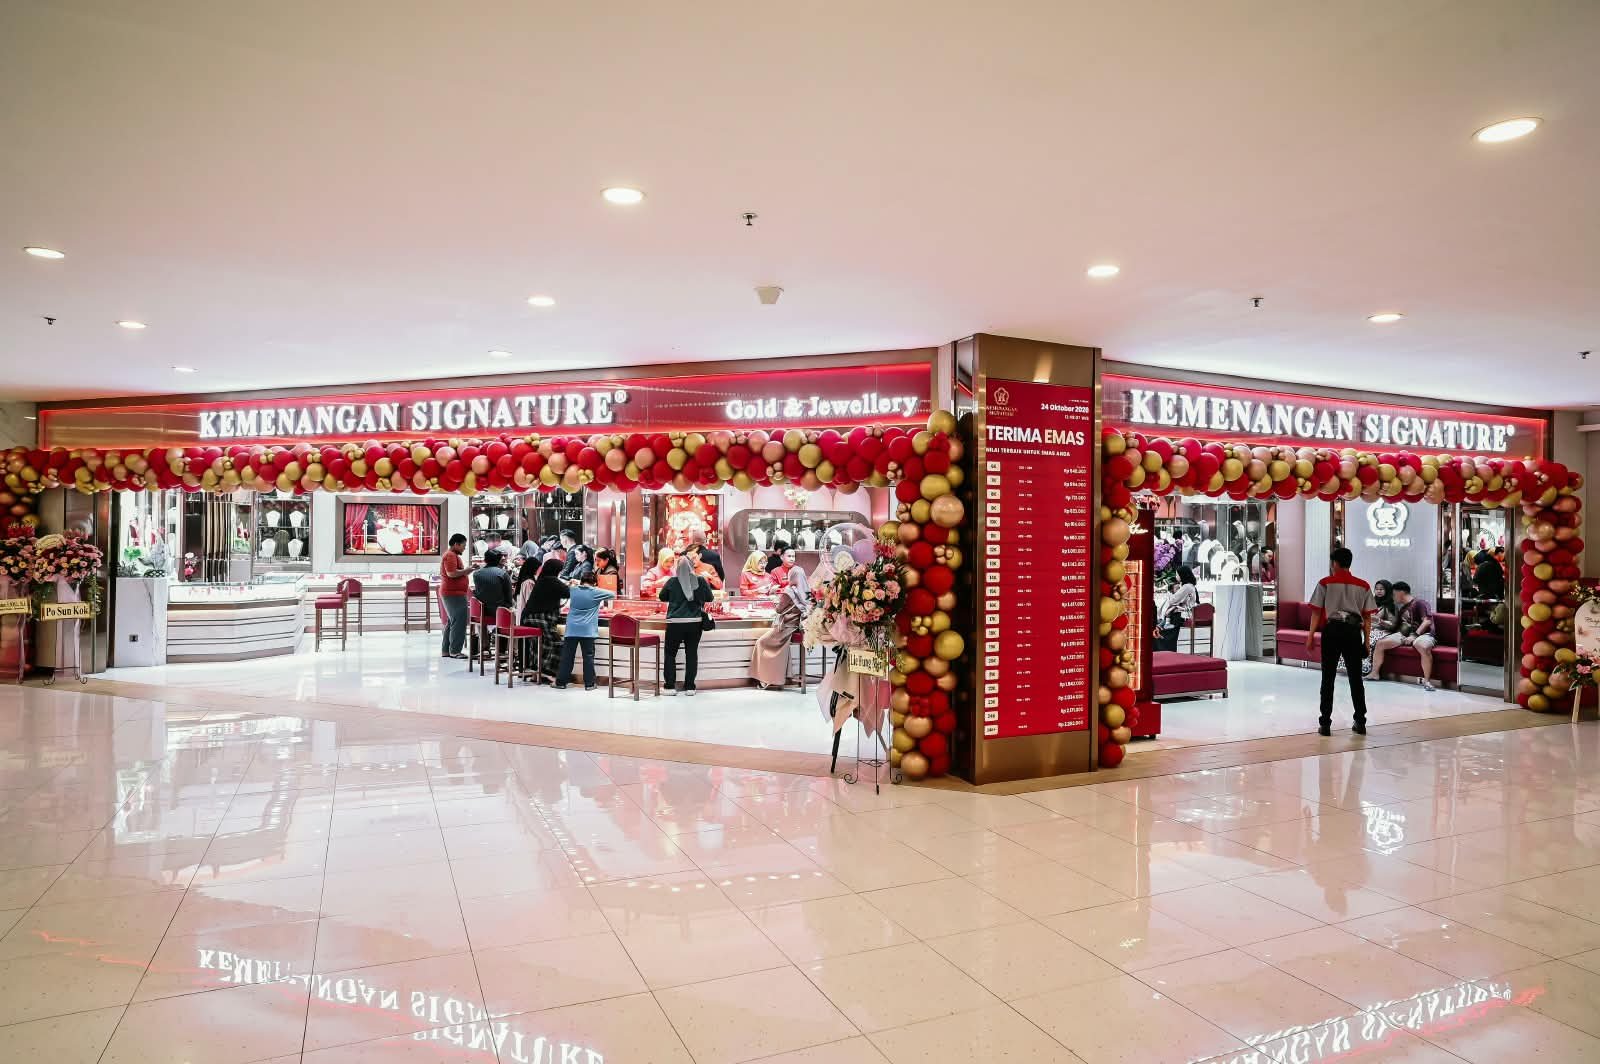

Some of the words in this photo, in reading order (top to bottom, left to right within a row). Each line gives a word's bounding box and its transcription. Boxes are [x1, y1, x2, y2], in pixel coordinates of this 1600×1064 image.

[726, 398, 778, 419] Gold
[784, 397, 802, 418] &
[808, 393, 918, 417] Jewellery
[1050, 404, 1074, 412] Oktober
[198, 402, 399, 438] KEMENANGAN
[1130, 388, 1354, 441] KEMENANGAN
[1364, 414, 1516, 452] SIGNATURE
[986, 424, 1042, 443] TERIMA
[1044, 429, 1084, 446] EMAS
[46, 607, 55, 616] Po
[57, 606, 72, 616] Sun
[73, 606, 88, 615] Kok
